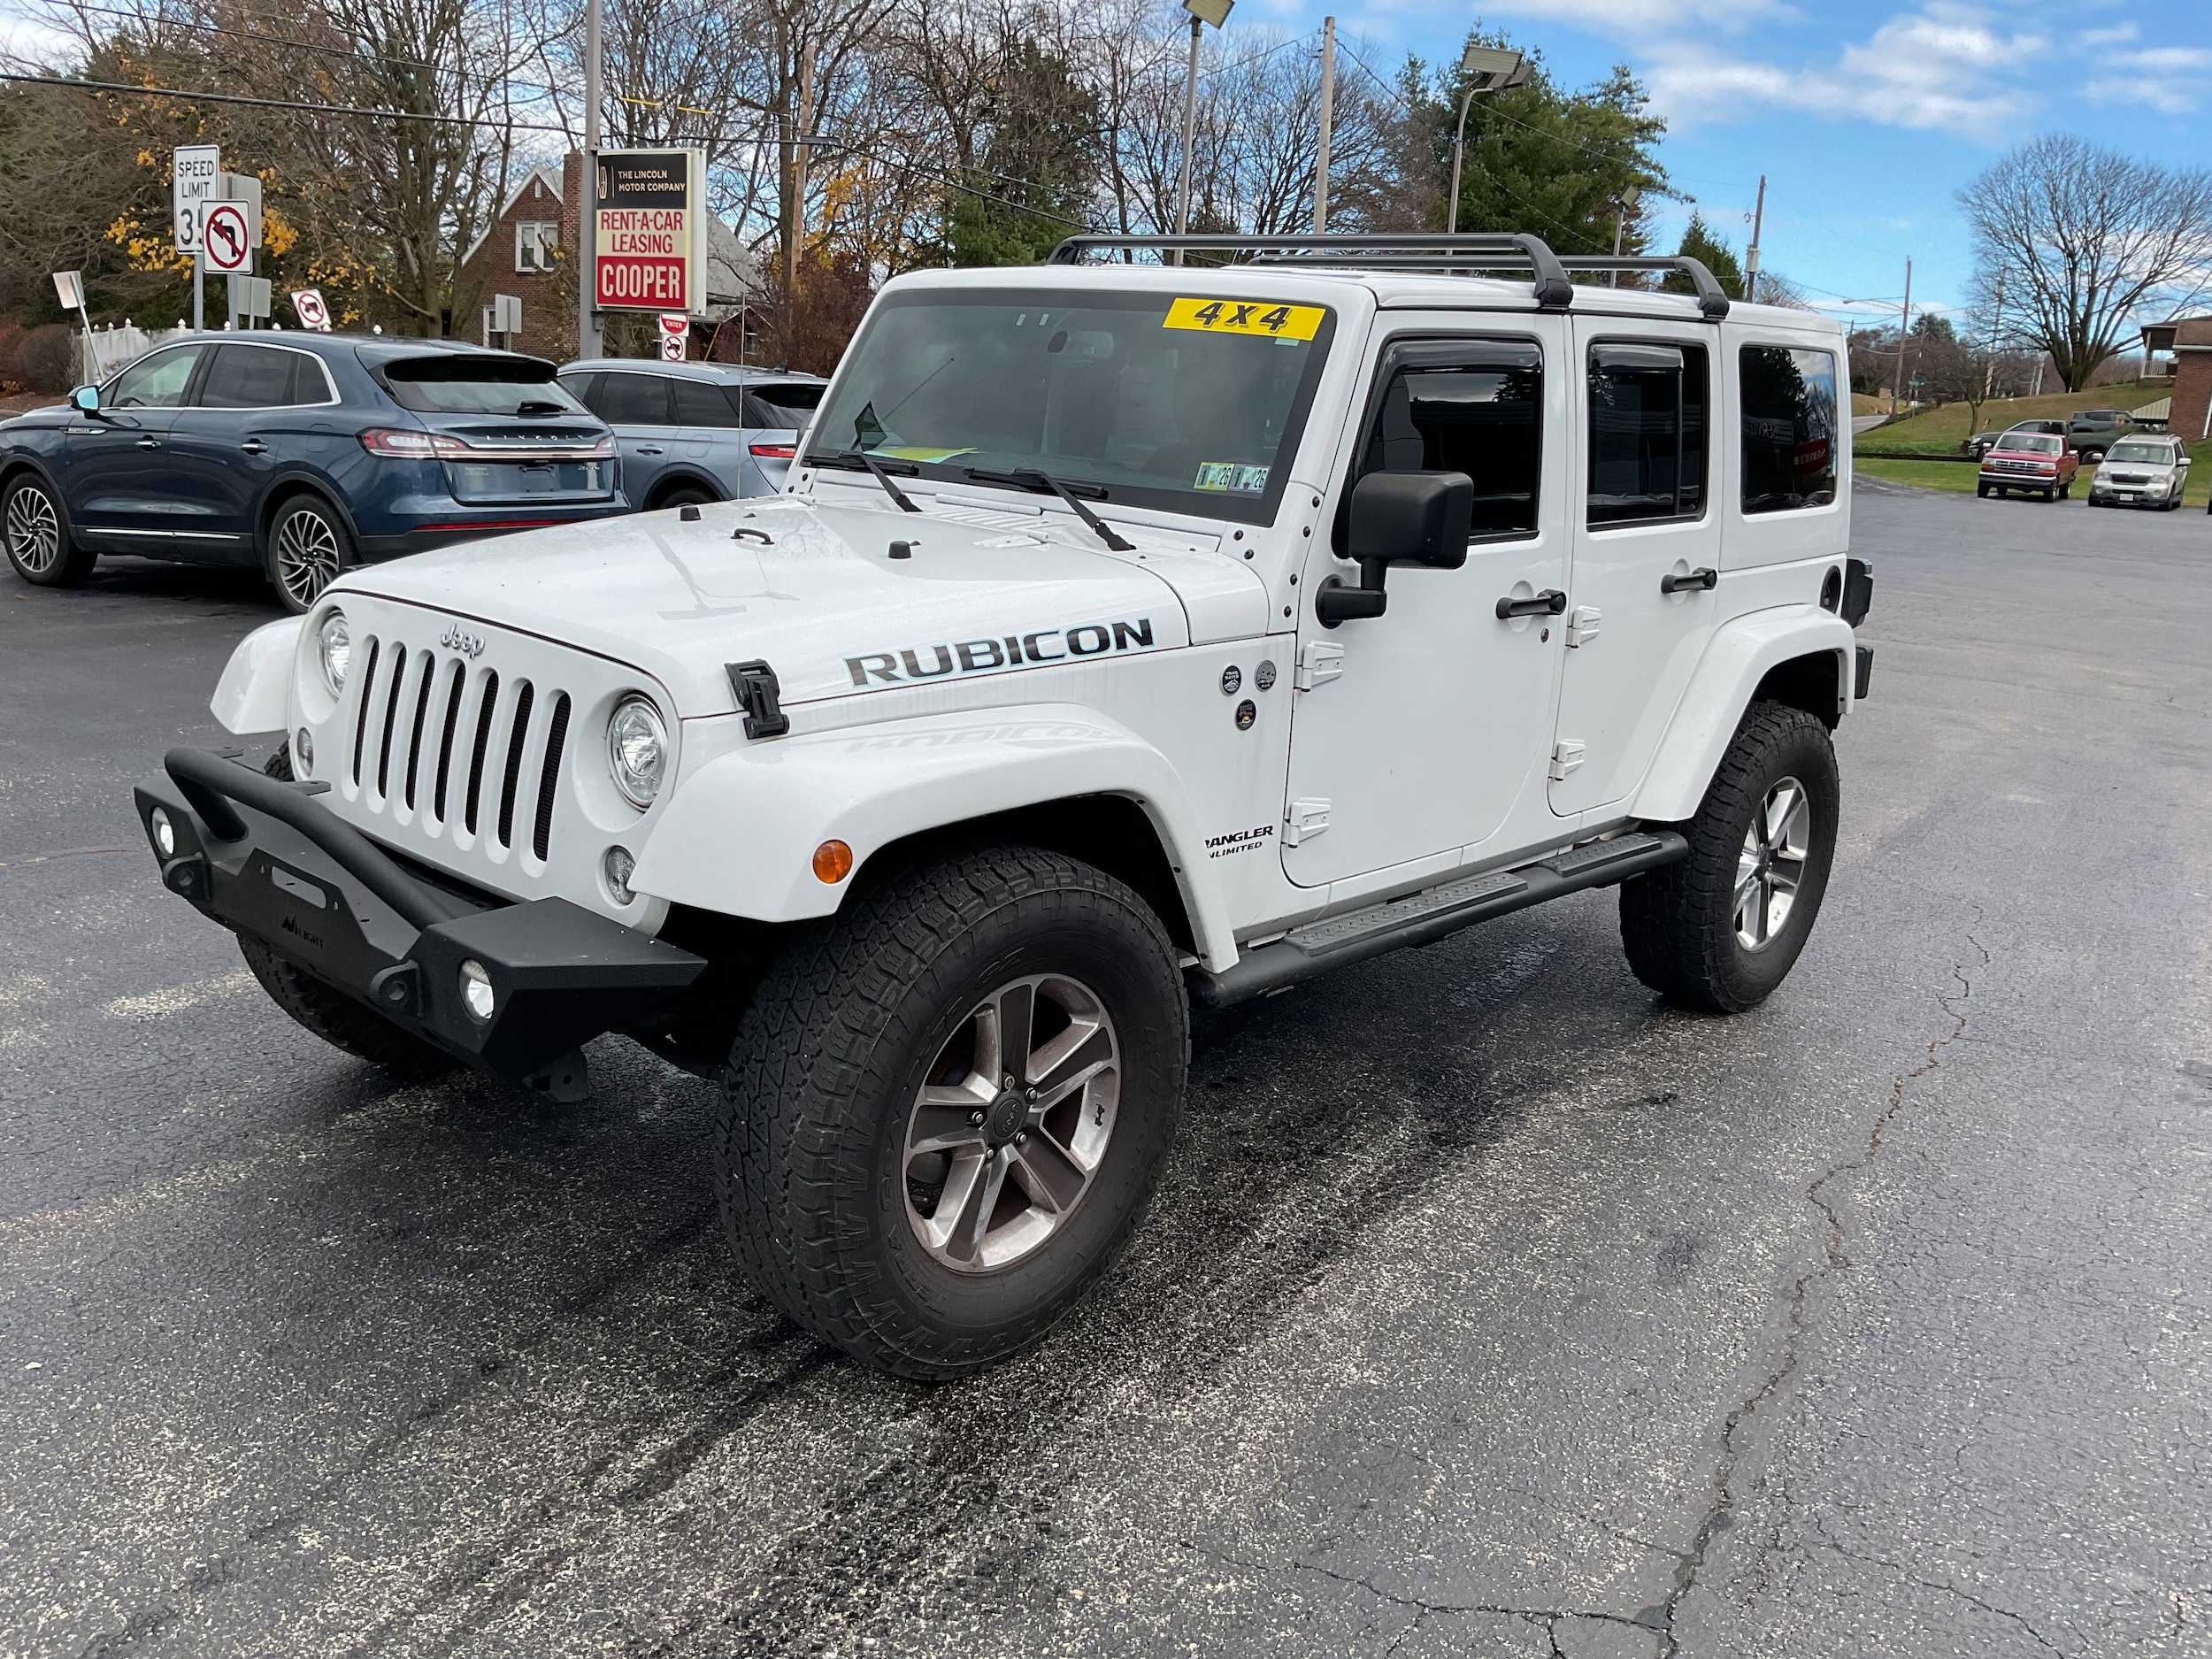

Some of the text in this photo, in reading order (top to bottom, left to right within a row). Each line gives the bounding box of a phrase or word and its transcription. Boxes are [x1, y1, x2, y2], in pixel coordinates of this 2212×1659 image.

[178, 160, 214, 177] SPEED
[618, 170, 668, 180] THE LINCOLN
[181, 181, 210, 198] LIMIT
[618, 182, 686, 192] MOTOR COMPANY
[601, 211, 683, 231] RENT-A-CAR
[611, 234, 673, 254] LEASING
[602, 264, 680, 299] COOPER
[665, 319, 683, 329] ENTER
[1219, 466, 1232, 486] 26
[1254, 469, 1267, 488] 26
[441, 623, 486, 661] Jeep
[843, 617, 1154, 687] RUBICON
